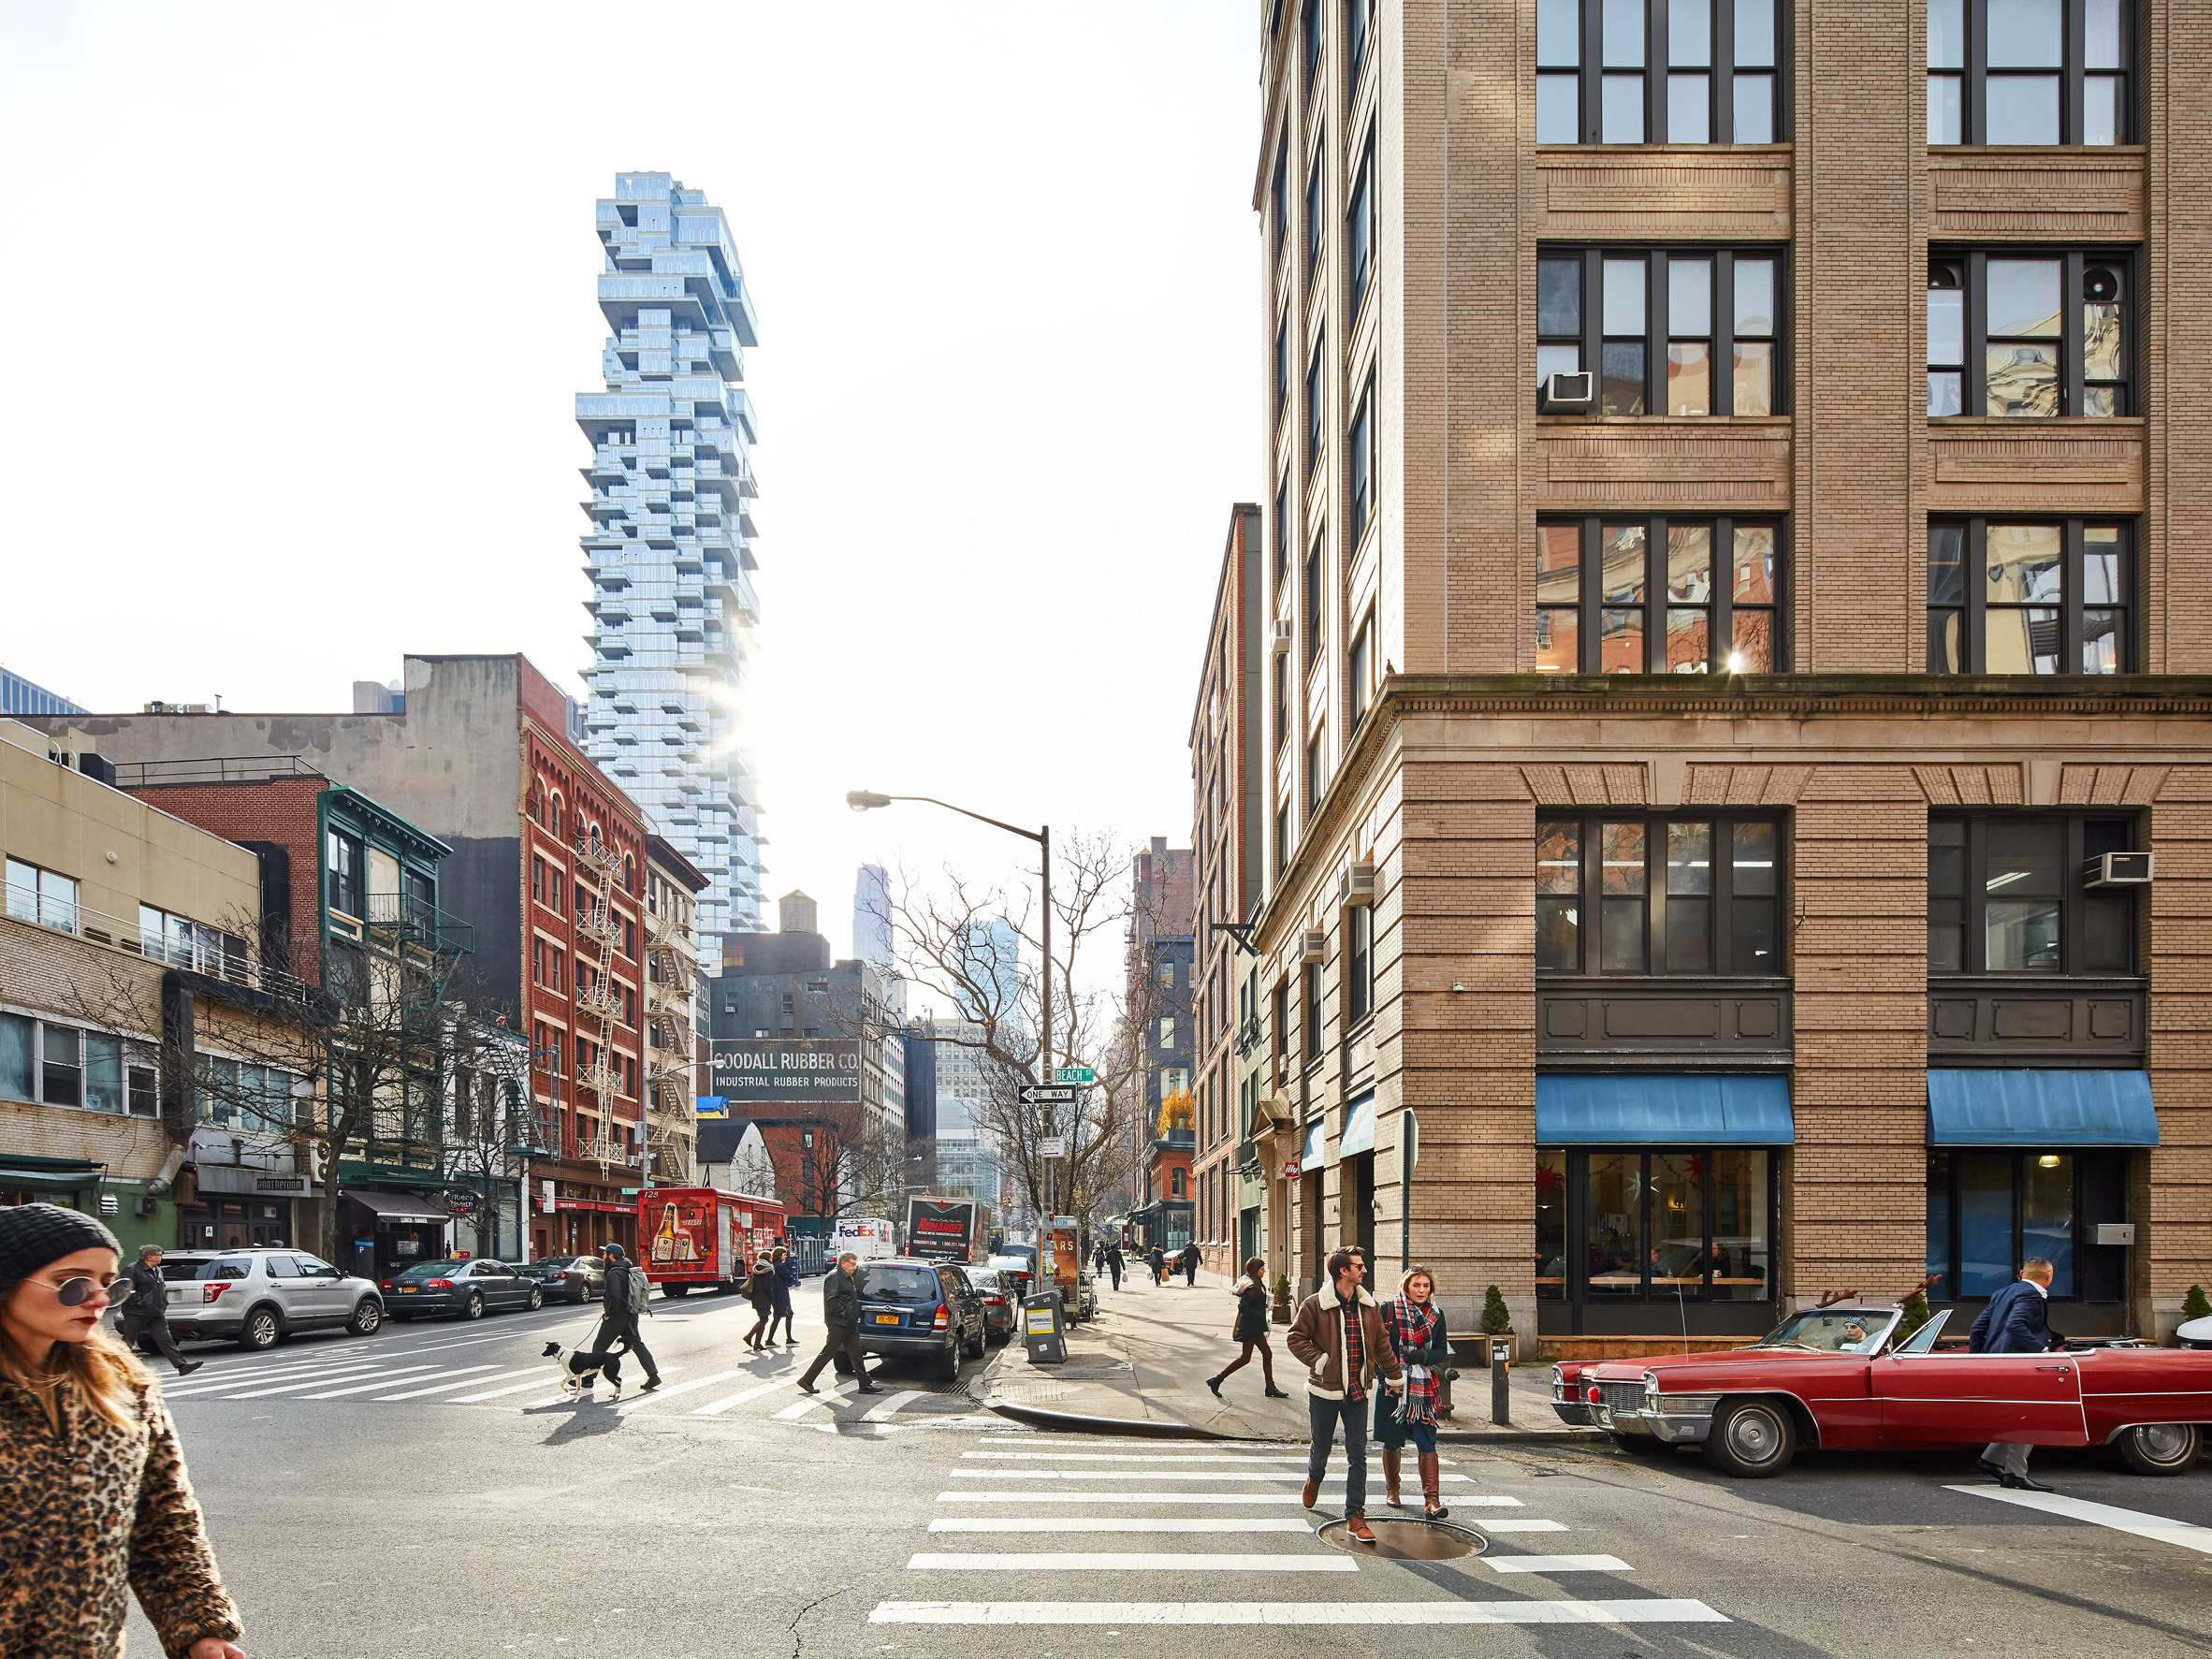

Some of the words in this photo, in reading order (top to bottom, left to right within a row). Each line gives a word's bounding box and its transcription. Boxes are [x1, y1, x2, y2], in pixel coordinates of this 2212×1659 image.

[780, 1053, 835, 1070] RUBBER
[838, 1053, 859, 1070] CO.
[1055, 1070, 1083, 1081] BEACH
[716, 1077, 770, 1087] INDUSTRIAL
[774, 1077, 809, 1087] RUBBER
[814, 1077, 858, 1087] PRODUCTS
[1026, 1090, 1043, 1099] ONE
[1051, 1090, 1069, 1099] WAY
[1285, 1164, 1298, 1175] illy
[257, 1180, 301, 1189] anotheroom
[918, 1217, 964, 1233] ROMANOFF
[839, 1226, 875, 1237] FedEx
